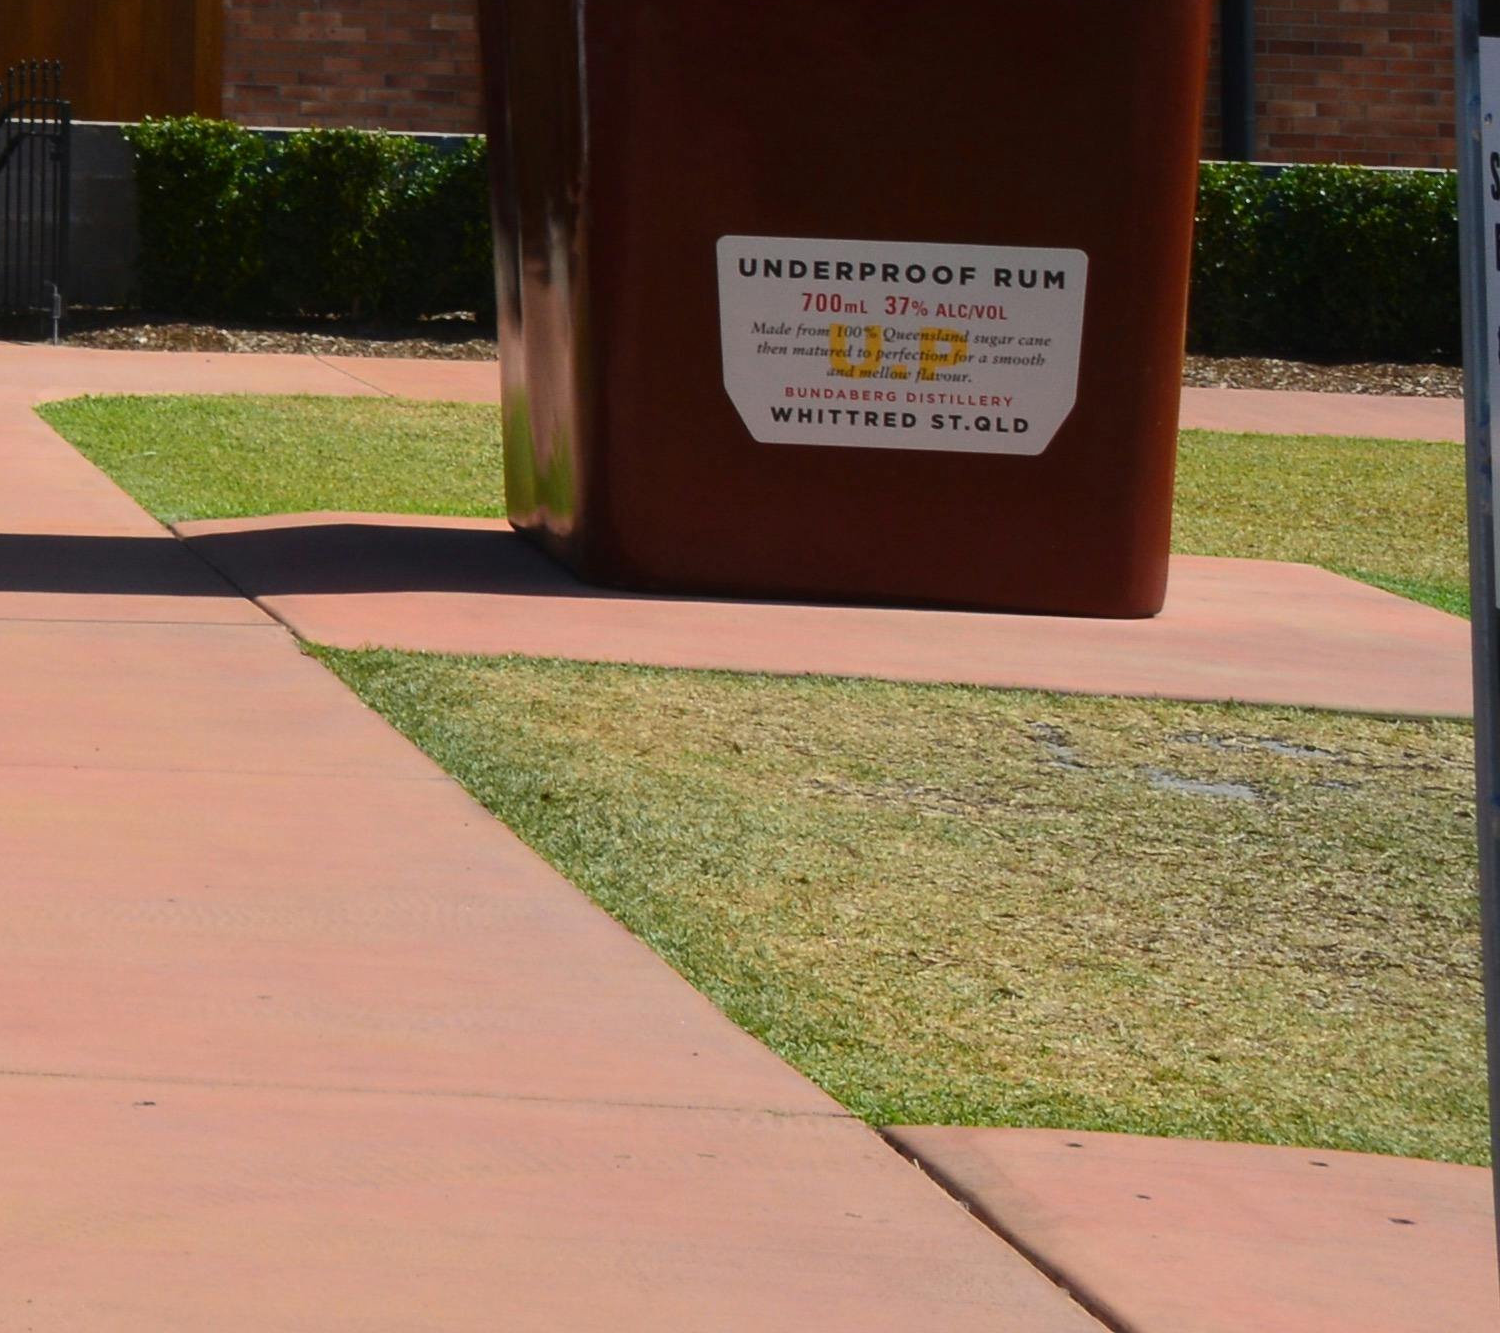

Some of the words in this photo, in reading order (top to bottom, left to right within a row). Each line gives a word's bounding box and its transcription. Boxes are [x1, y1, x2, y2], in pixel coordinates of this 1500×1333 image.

[738, 257, 977, 286] UNDERPROOF
[994, 268, 1065, 290] RUM
[884, 295, 928, 317] 37%
[936, 303, 1009, 321] ALC/VOL
[750, 321, 792, 336] Made
[796, 323, 830, 339] from
[836, 325, 878, 339] 100%
[883, 326, 970, 343] Queensland
[973, 335, 1015, 348] sugar
[1018, 338, 1052, 347] cane
[756, 341, 788, 356] then
[792, 345, 853, 359] matured
[857, 347, 872, 359] to
[875, 346, 949, 365] perfection
[953, 351, 978, 367] for
[978, 355, 989, 364] a
[992, 353, 1046, 367] smooth
[826, 364, 855, 378] and
[859, 366, 912, 381] mellow
[915, 367, 973, 384] flavour.
[784, 386, 898, 403] BUNDABERG
[906, 391, 1015, 408] DISTILLERY
[771, 406, 917, 429] WHITTRED
